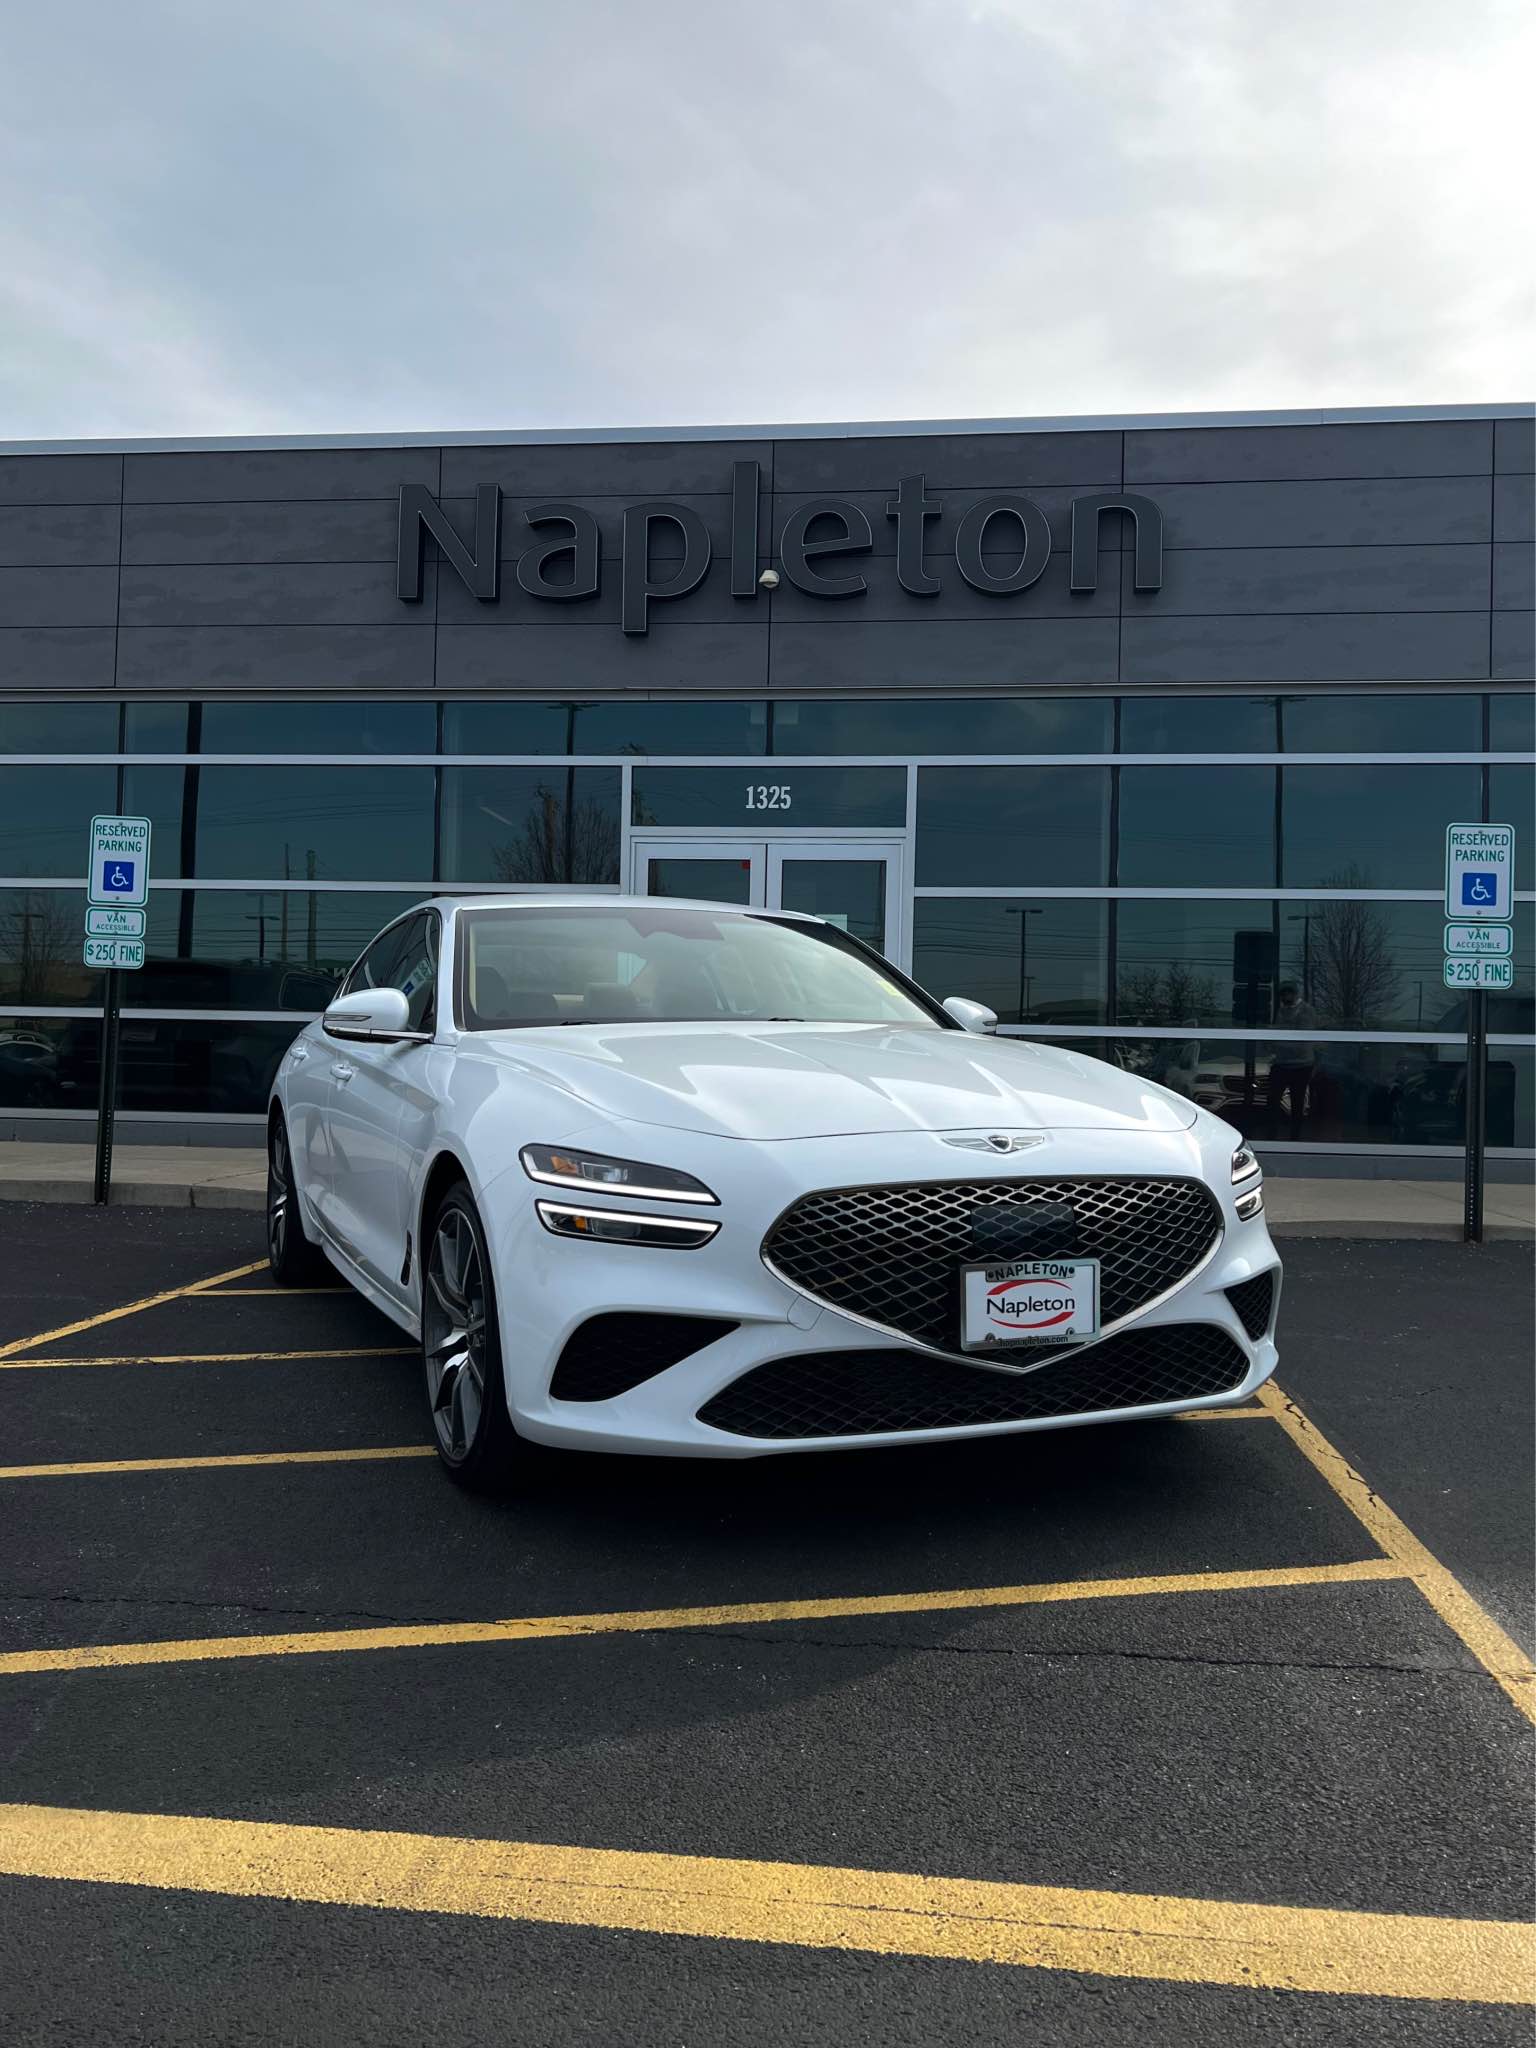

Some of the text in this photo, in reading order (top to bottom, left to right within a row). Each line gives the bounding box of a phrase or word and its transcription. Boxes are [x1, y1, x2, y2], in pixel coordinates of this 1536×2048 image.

[397, 461, 1164, 636] Napleton
[745, 785, 792, 809] 1325
[95, 825, 146, 838] RESERVED
[1451, 833, 1509, 846] RESERVED
[98, 840, 142, 853] PARKING
[1455, 849, 1505, 862] PARKING
[106, 914, 126, 923] VAN
[96, 924, 136, 932] ACCESSIBLE
[1467, 931, 1490, 940] VAN
[1456, 941, 1500, 949] ACCESSIBLE
[120, 945, 141, 962] FINE
[1484, 964, 1509, 982] FINE
[995, 1263, 1068, 1280] NAPLETON
[986, 1296, 1075, 1318] Napleton
